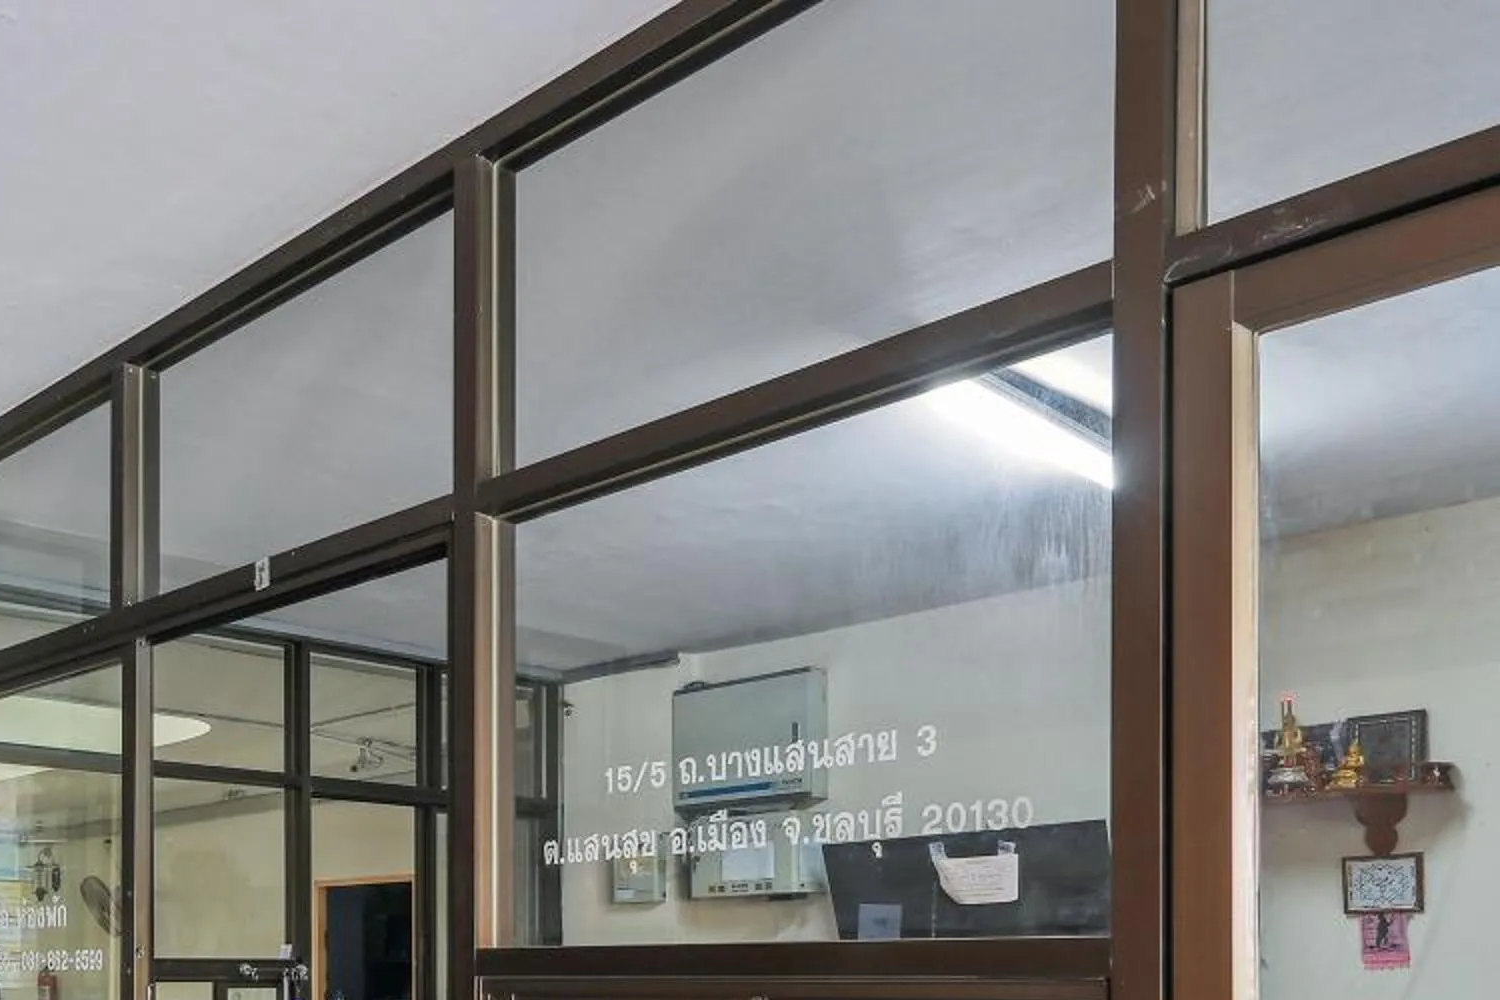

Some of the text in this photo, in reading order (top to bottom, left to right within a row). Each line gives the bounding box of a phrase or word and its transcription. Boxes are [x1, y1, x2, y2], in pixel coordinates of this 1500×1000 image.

[604, 724, 938, 797] 15/5 ถ.บางแสนสาย 3
[543, 791, 1035, 875] ต.แสนสุข อ.เมือง จ.ชลบุรี 20130
